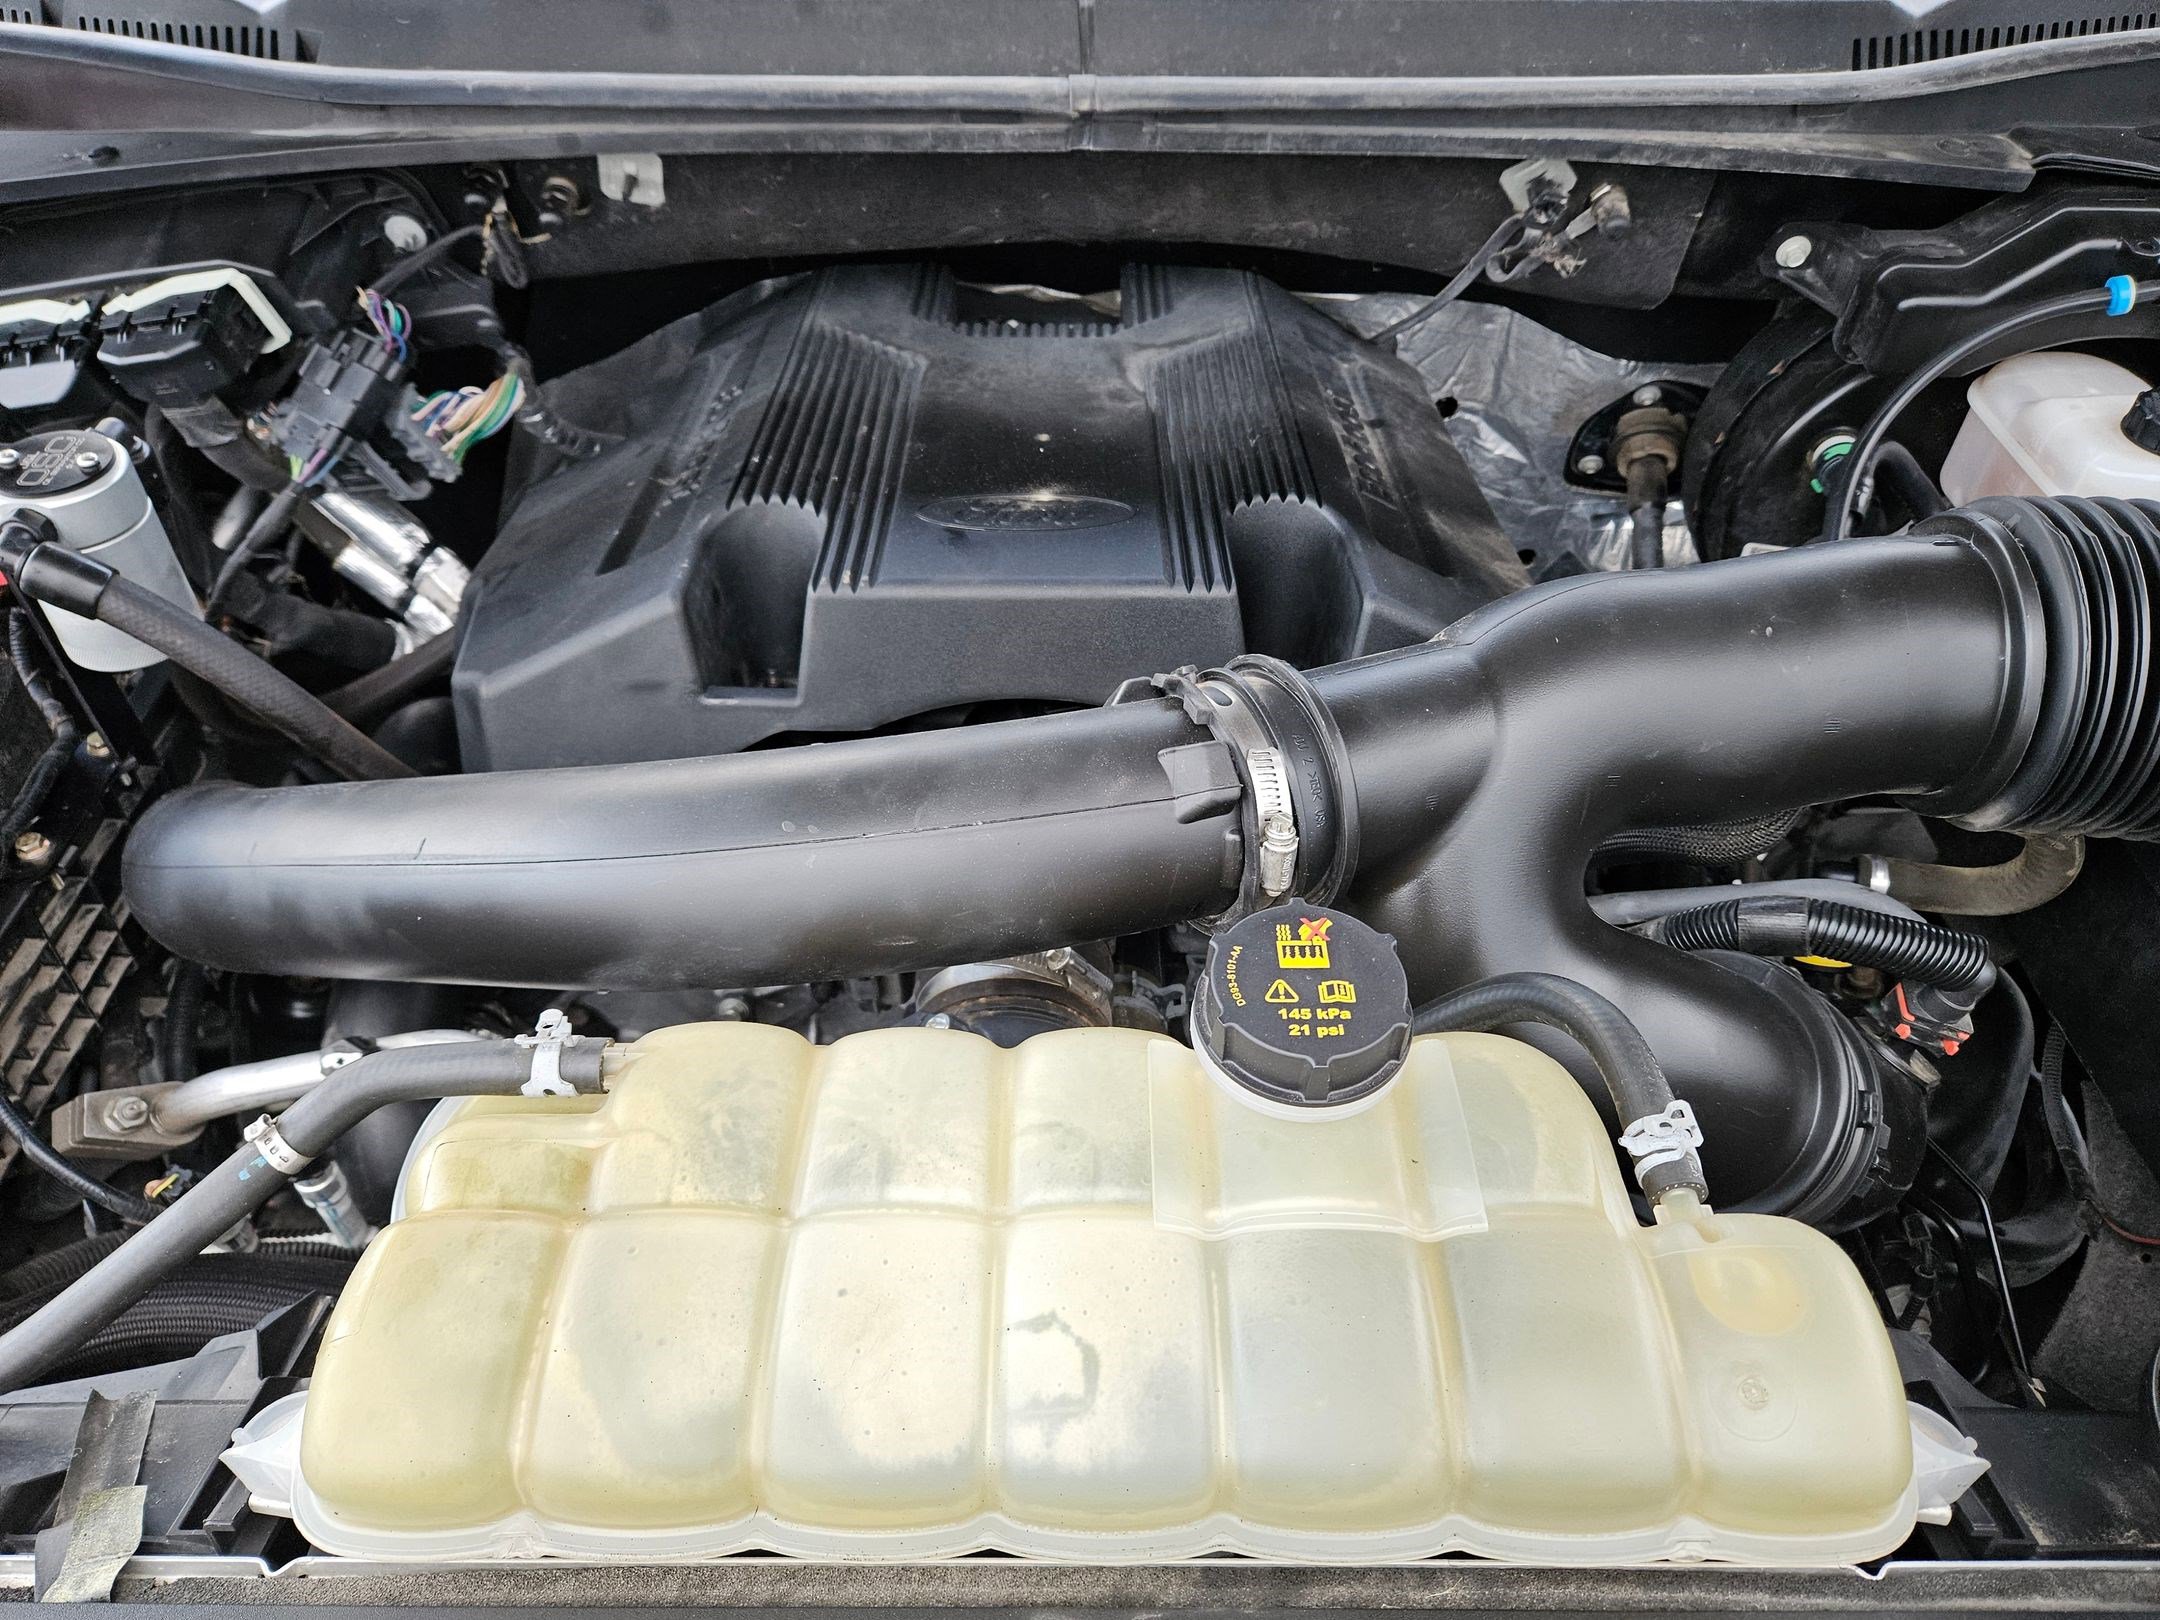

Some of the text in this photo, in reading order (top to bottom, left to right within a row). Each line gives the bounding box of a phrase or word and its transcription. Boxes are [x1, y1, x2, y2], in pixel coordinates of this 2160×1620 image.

[1226, 945, 1246, 1007] DG93-8101-AA
[1278, 1008, 1351, 1020] 145 kPa
[1288, 1024, 1344, 1038] 21 psi
